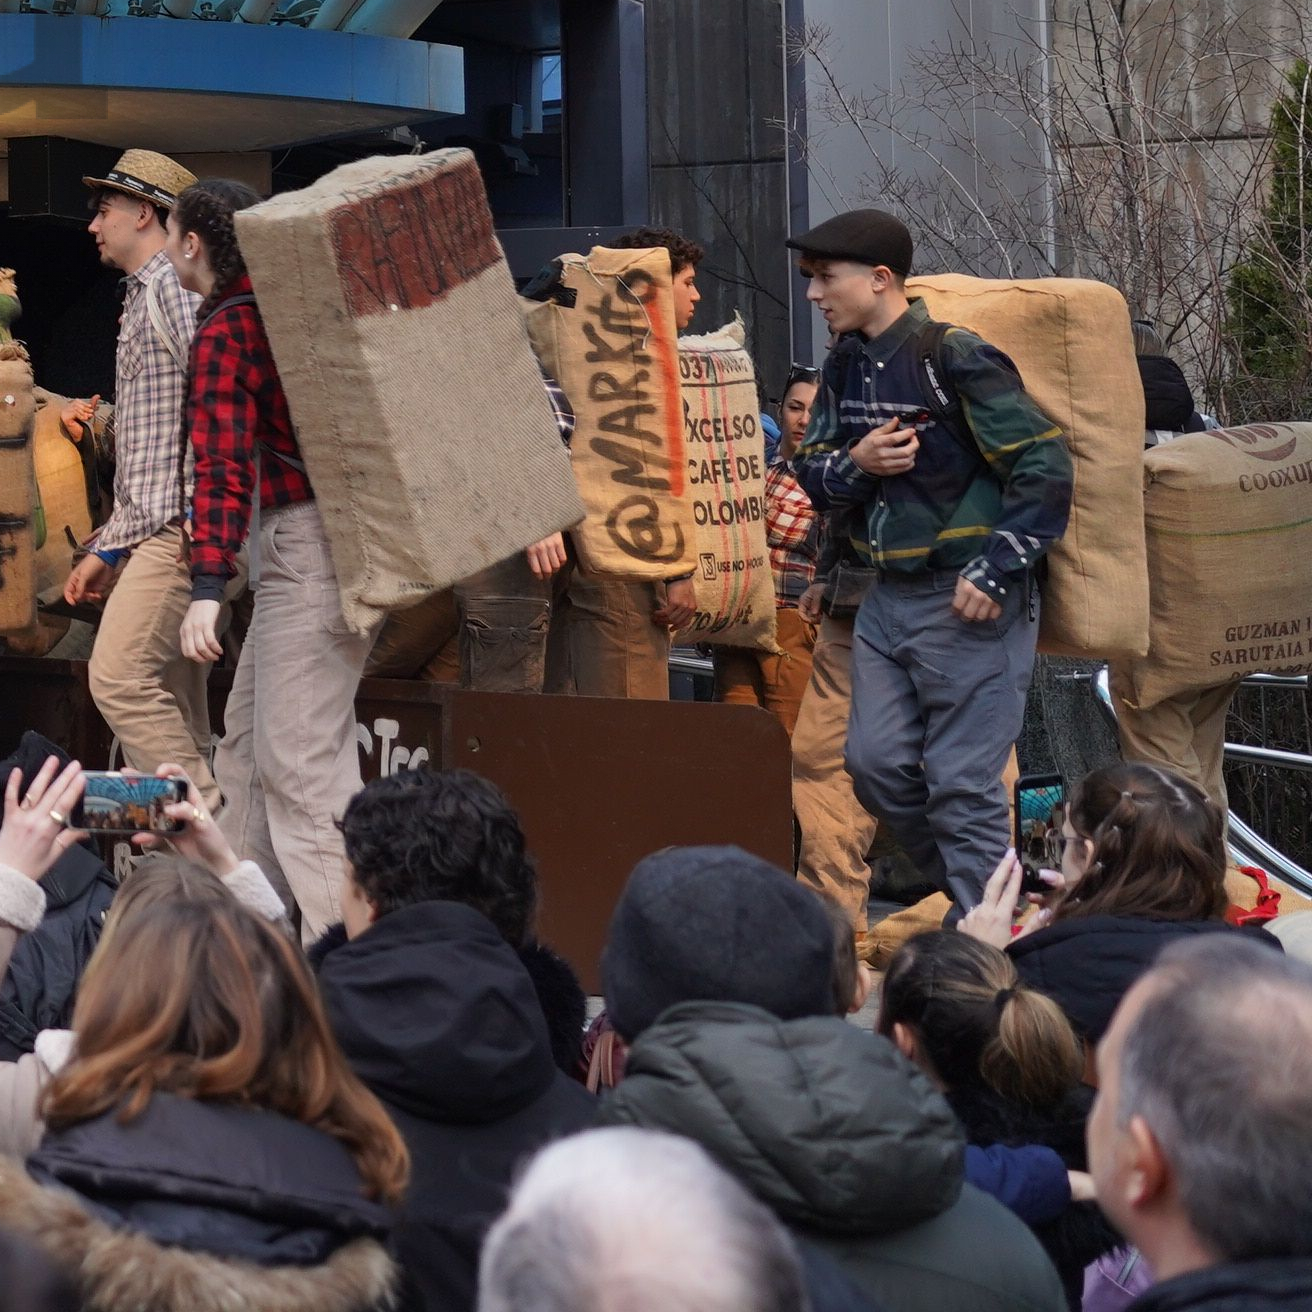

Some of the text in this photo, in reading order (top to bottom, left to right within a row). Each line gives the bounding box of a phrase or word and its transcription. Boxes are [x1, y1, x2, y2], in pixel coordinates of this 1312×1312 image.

[736, 455, 761, 481] DE
[718, 561, 731, 573] USE
[732, 560, 744, 572] NO
[1225, 619, 1301, 643] GUZMAN
